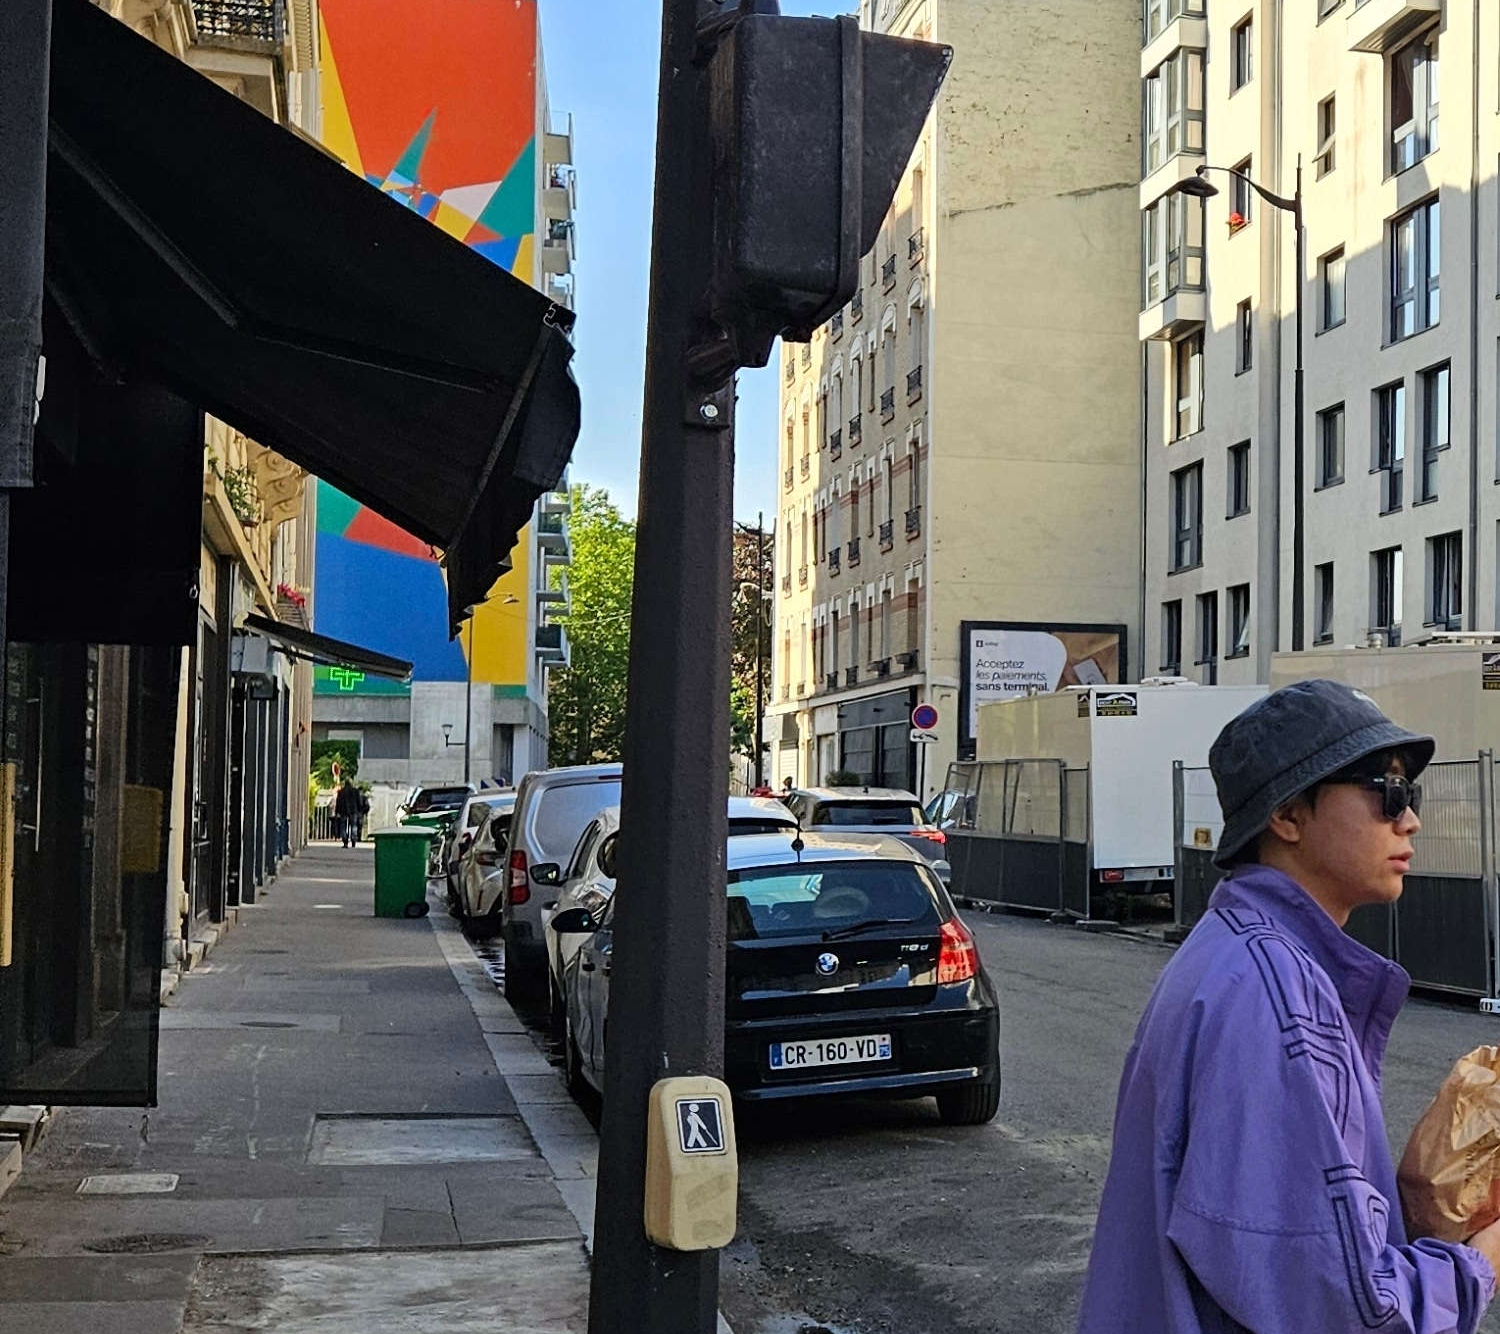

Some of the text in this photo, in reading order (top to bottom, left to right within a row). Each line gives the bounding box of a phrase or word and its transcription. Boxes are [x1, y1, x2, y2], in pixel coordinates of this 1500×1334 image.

[975, 658, 1025, 670] Acceptez
[975, 671, 1048, 682] les paiements,
[975, 682, 1002, 691] sans
[784, 1038, 877, 1065] CR-160-VD
